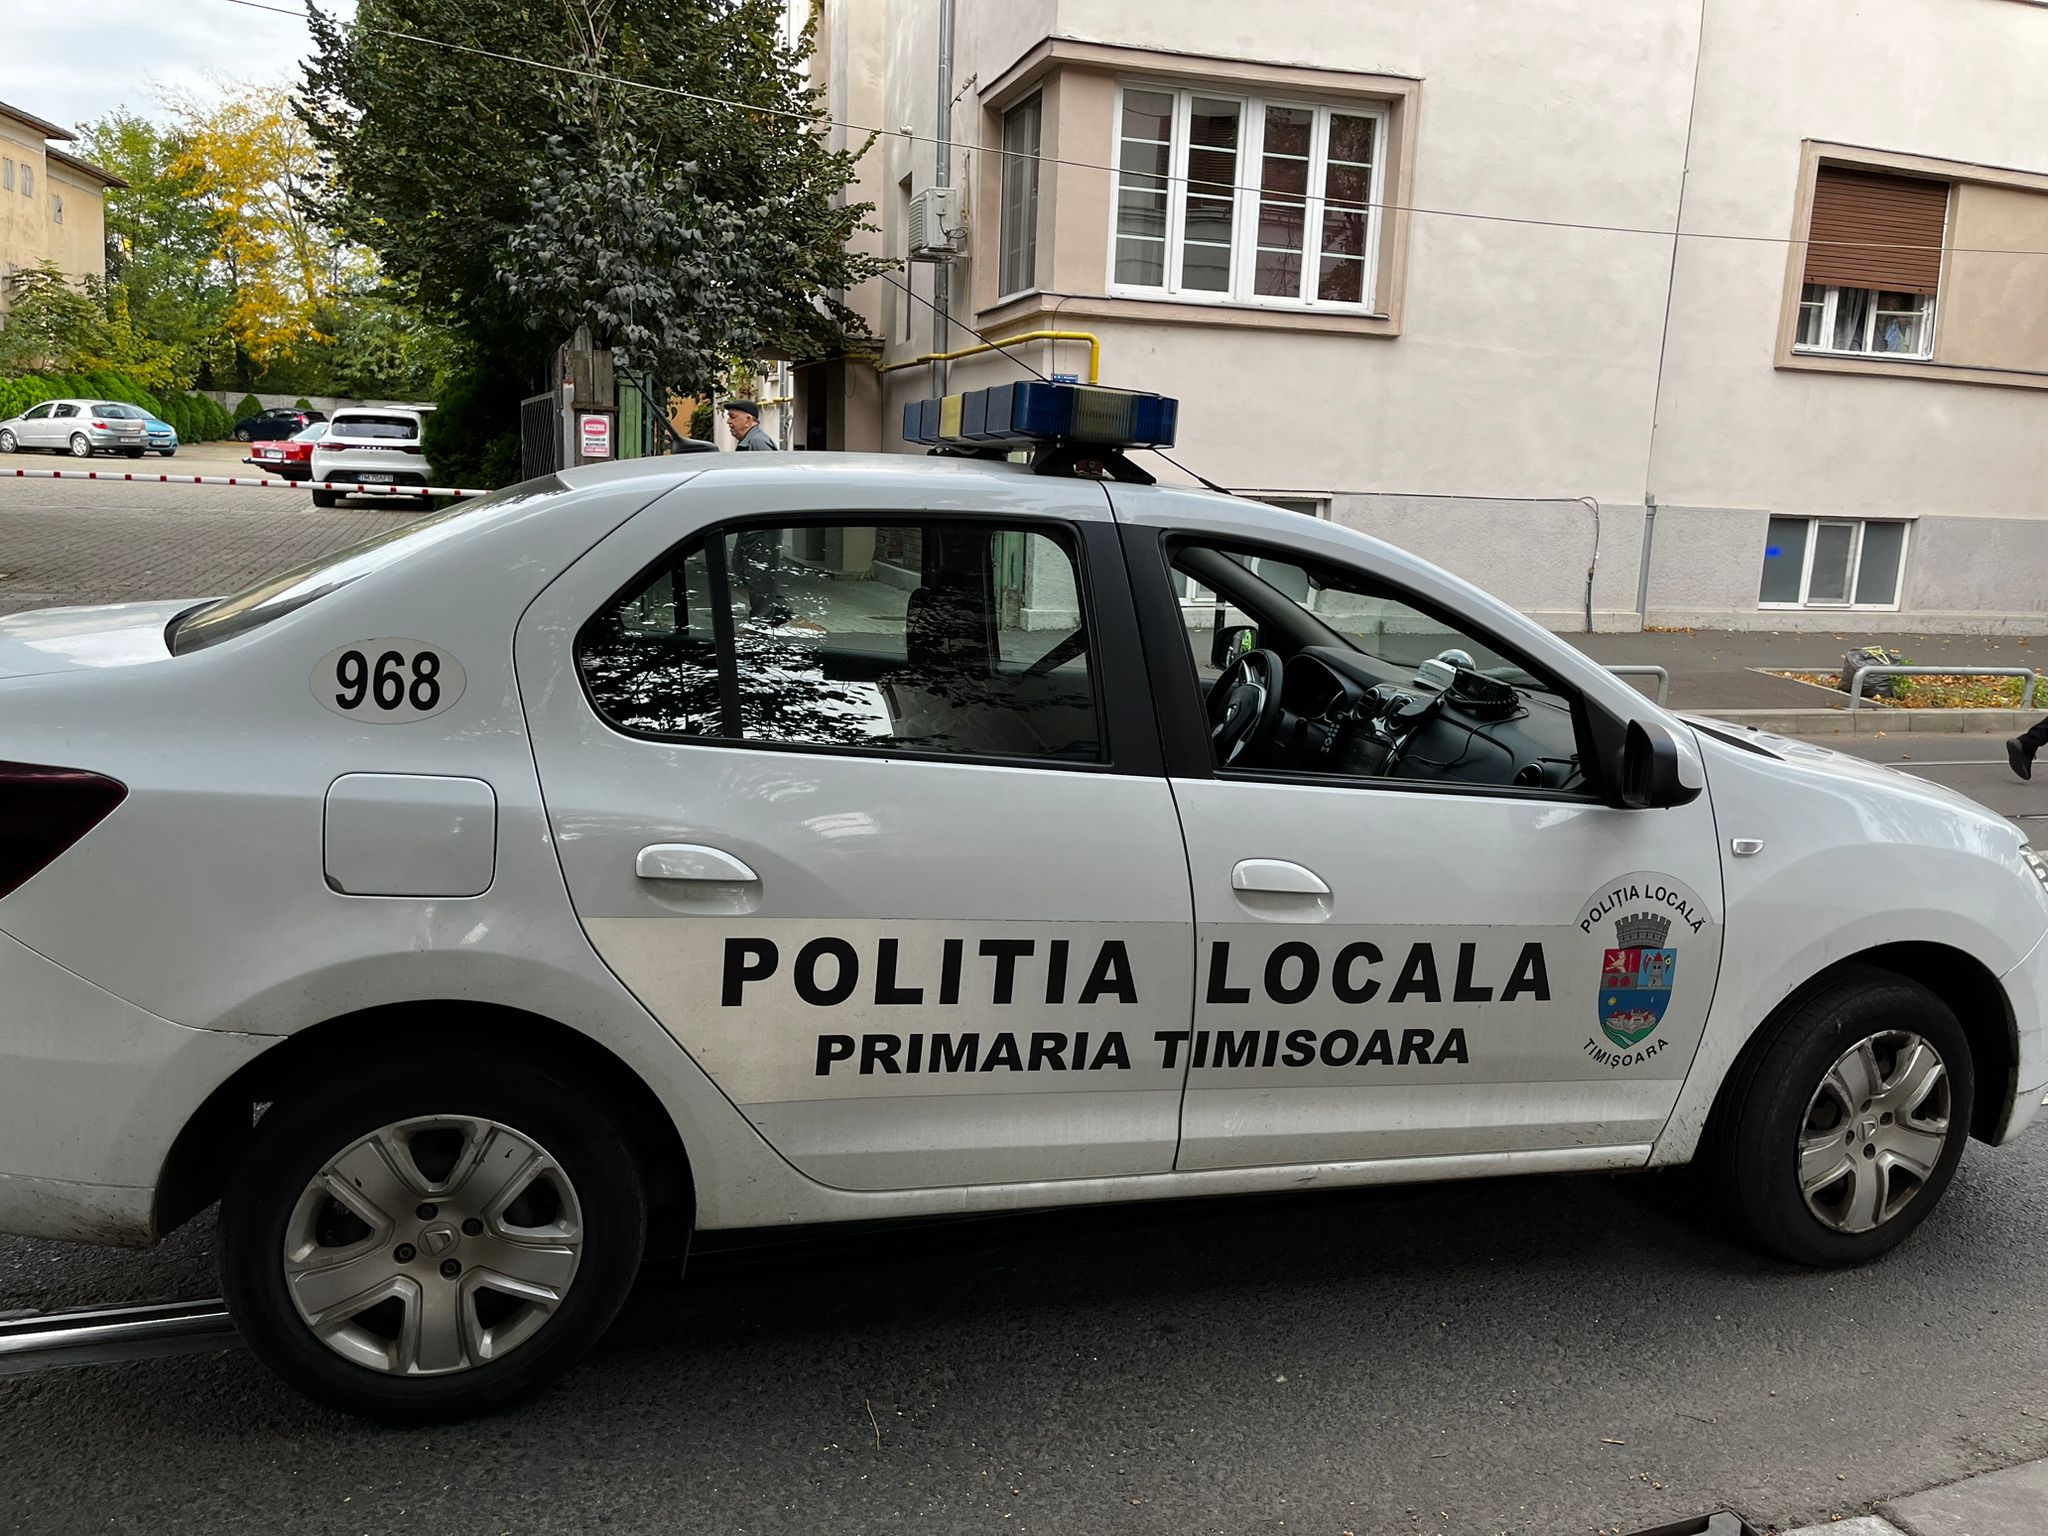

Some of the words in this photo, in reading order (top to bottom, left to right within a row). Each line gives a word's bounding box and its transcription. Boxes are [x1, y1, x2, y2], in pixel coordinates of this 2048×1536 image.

[335, 649, 441, 712] 968
[1645, 884, 1706, 934] LOCALĂ
[722, 936, 1139, 1007] POLITIA
[1205, 941, 1551, 1005] LOCALA
[815, 1031, 1132, 1076] PRIMARIA
[1153, 1027, 1469, 1069] TIMISOARA
[1583, 1037, 1669, 1069] TIMIȘOARA
